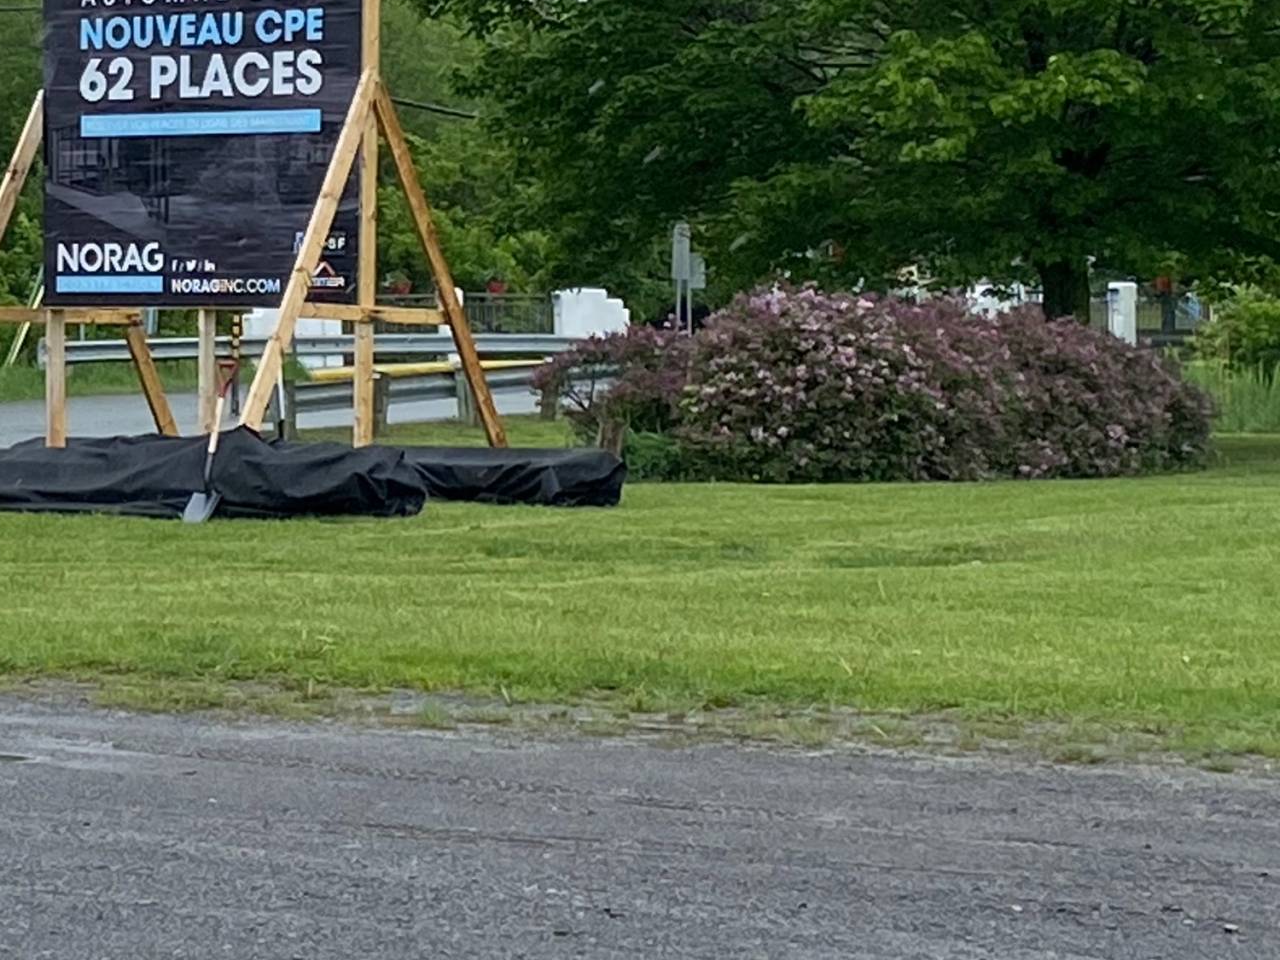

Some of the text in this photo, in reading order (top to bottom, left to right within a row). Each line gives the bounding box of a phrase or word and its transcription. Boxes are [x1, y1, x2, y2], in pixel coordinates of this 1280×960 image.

[80, 8, 323, 50] NOUVEAU CPE
[79, 49, 322, 102] 62 PLACES
[57, 242, 164, 273] NORAG
